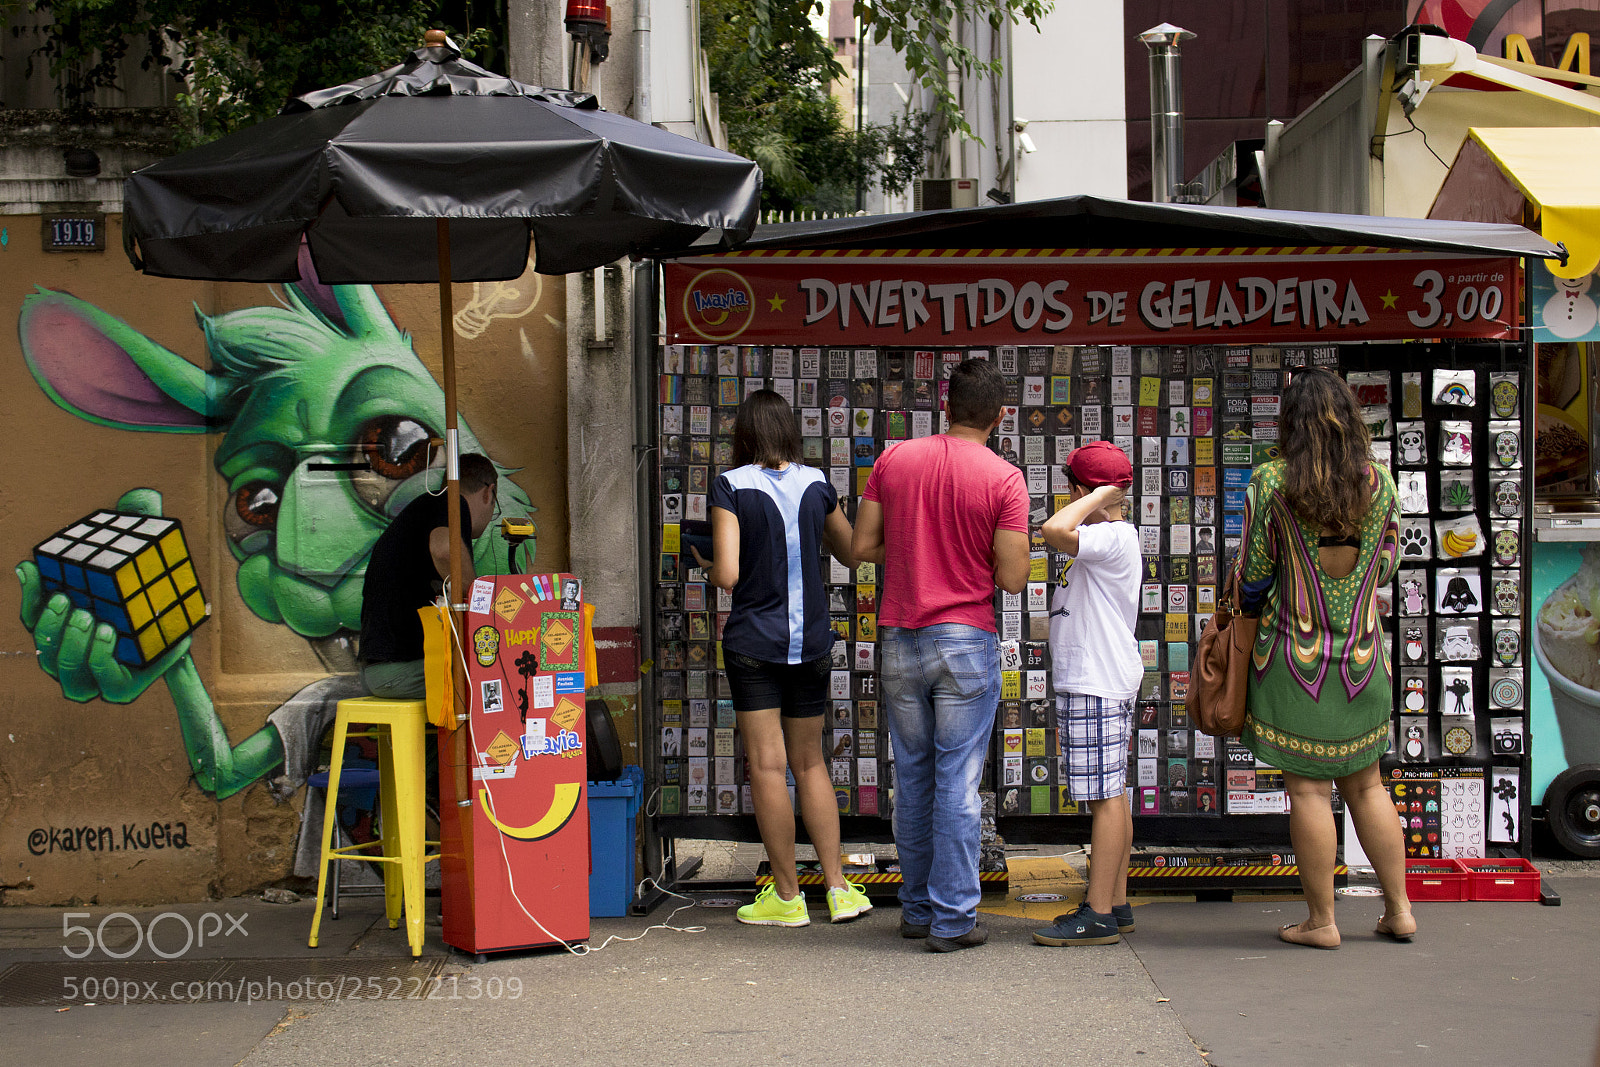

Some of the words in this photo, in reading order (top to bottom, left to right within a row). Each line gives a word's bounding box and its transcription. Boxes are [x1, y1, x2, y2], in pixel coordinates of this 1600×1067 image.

[54, 222, 94, 242] 1919
[1458, 273, 1487, 285] partir
[1490, 273, 1504, 283] de
[800, 278, 1073, 333] DIVERTIDOS
[1086, 291, 1128, 324] DE
[1140, 277, 1370, 330] GELADEIRA
[1407, 269, 1501, 329] 3,00
[831, 351, 847, 359] FALE
[1285, 350, 1306, 358] SEJA
[1313, 347, 1337, 359] SHIT
[803, 360, 818, 369] DE
[1285, 358, 1306, 366] FODA
[831, 370, 847, 378] MAIS
[1030, 588, 1034, 596] I
[504, 626, 541, 648] HAPPY
[1007, 654, 1018, 667] SP
[1028, 657, 1042, 665] SP
[862, 675, 874, 694] FÉ
[1169, 857, 1187, 866] LOUSA
